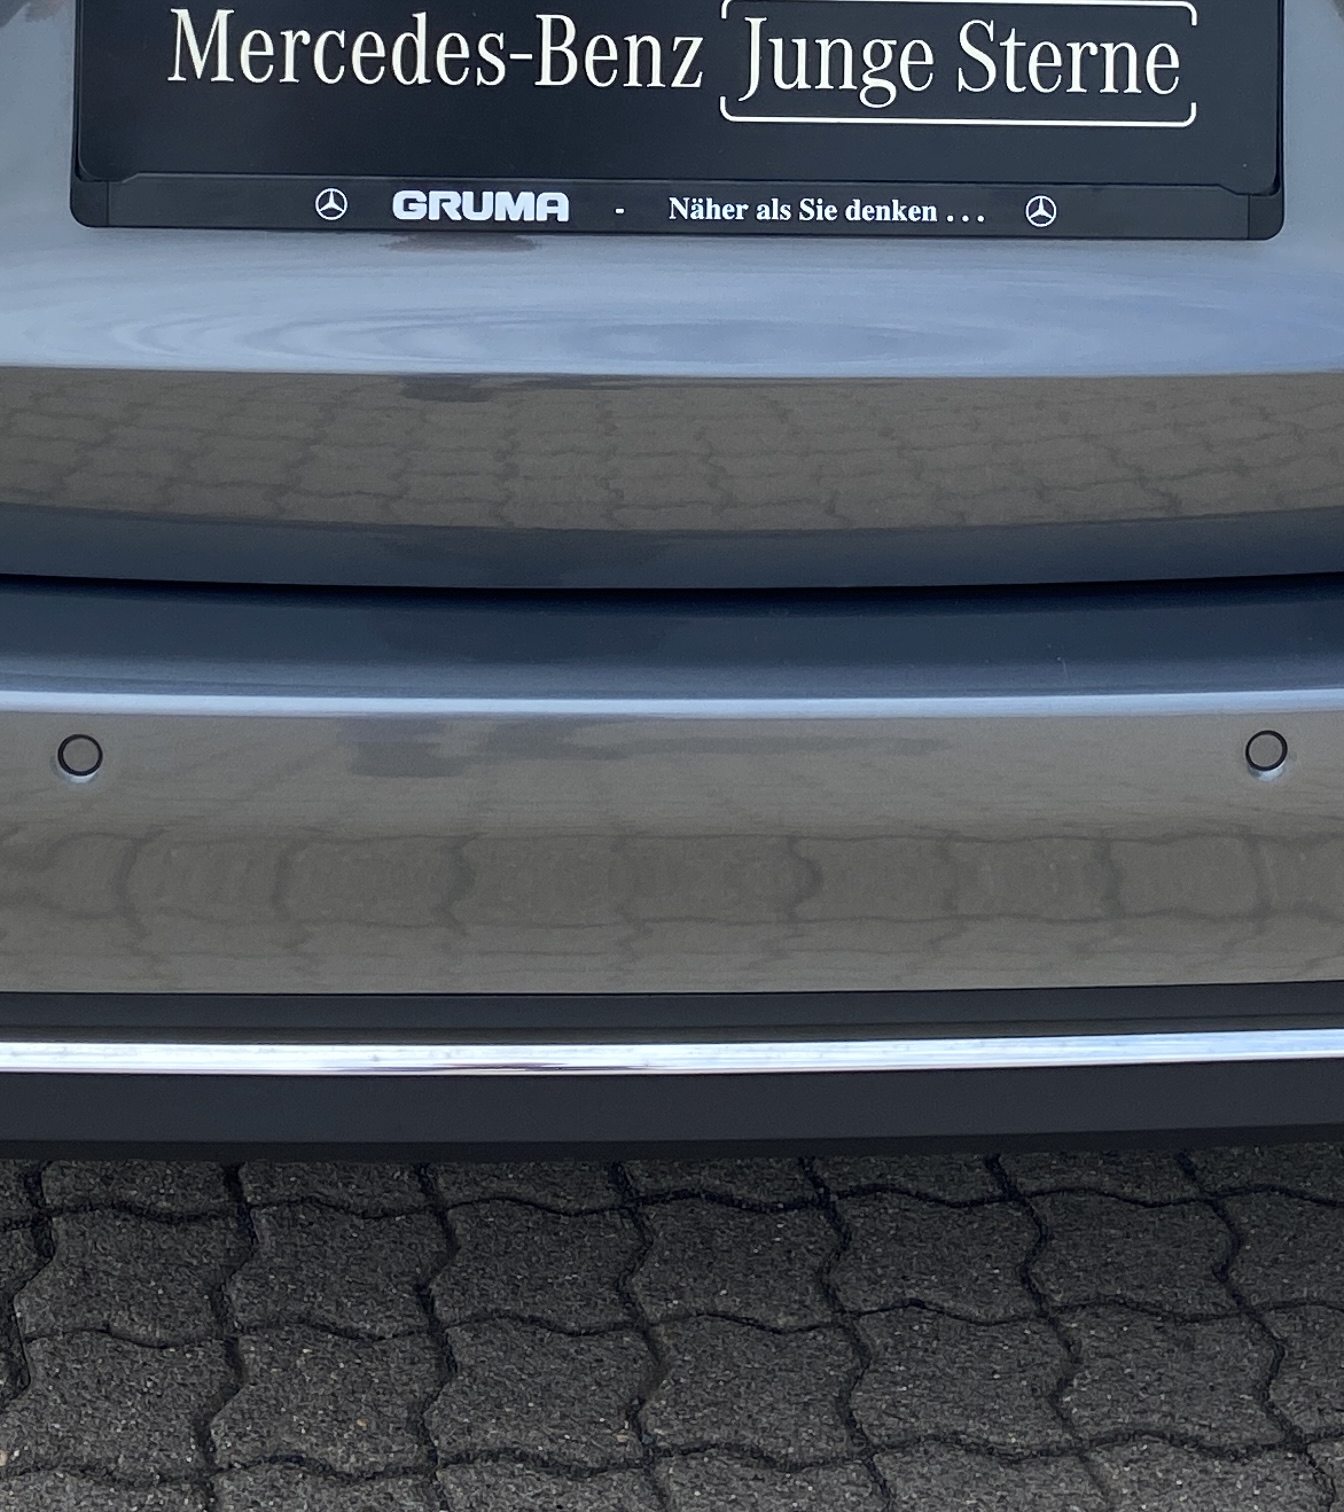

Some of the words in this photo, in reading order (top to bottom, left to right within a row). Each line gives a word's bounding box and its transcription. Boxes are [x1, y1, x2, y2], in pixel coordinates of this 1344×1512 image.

[167, 8, 704, 88] Mercedes-Benz
[738, 16, 934, 109] Junge
[958, 19, 1180, 95] Sterne
[392, 190, 570, 222] GRUMA
[668, 196, 750, 220] Näher
[756, 197, 792, 221] als
[798, 197, 838, 221] Sie
[845, 198, 938, 223] denken
